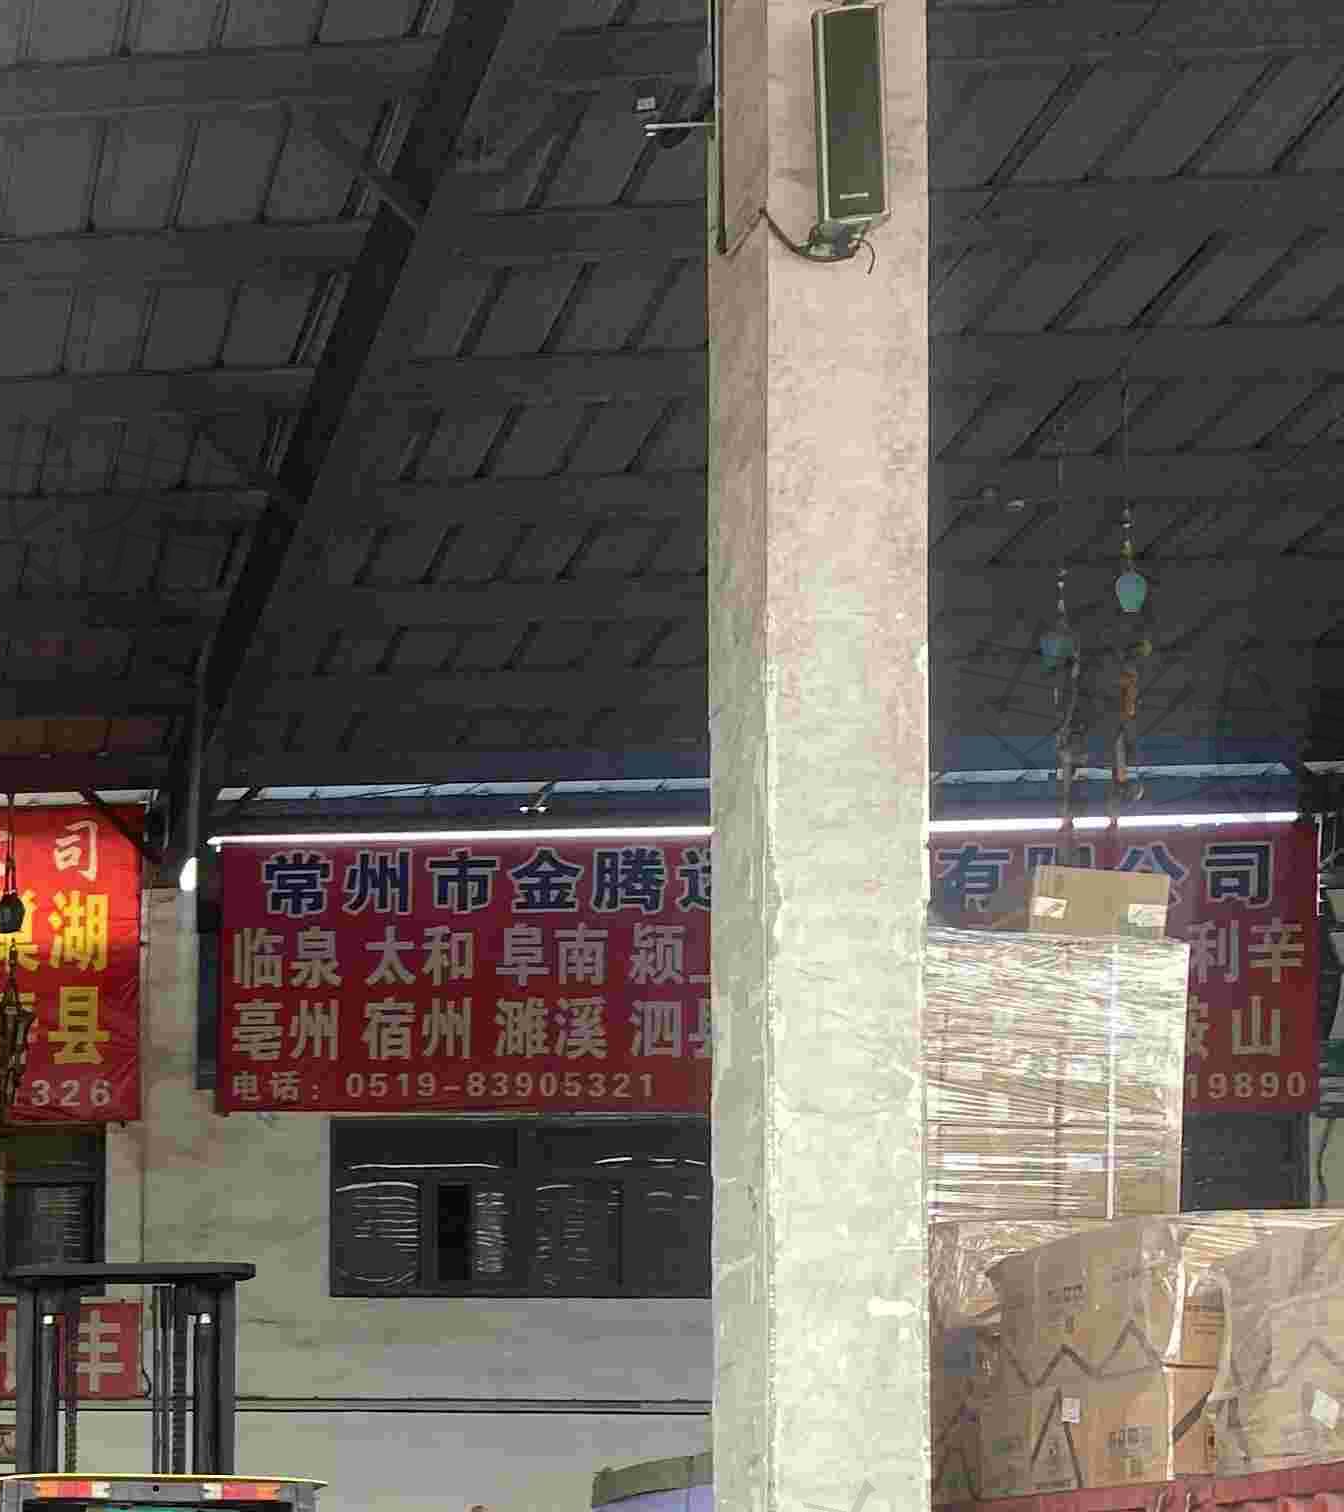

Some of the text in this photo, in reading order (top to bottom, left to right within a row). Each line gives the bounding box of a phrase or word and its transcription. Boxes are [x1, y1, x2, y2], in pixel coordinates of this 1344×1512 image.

[231, 926, 342, 989] 临泉
[365, 925, 474, 987] 太和
[495, 921, 608, 985] 阜南
[1185, 919, 1305, 984] 利辛
[365, 997, 473, 1060] 宿州
[495, 996, 608, 1060] 濉溪
